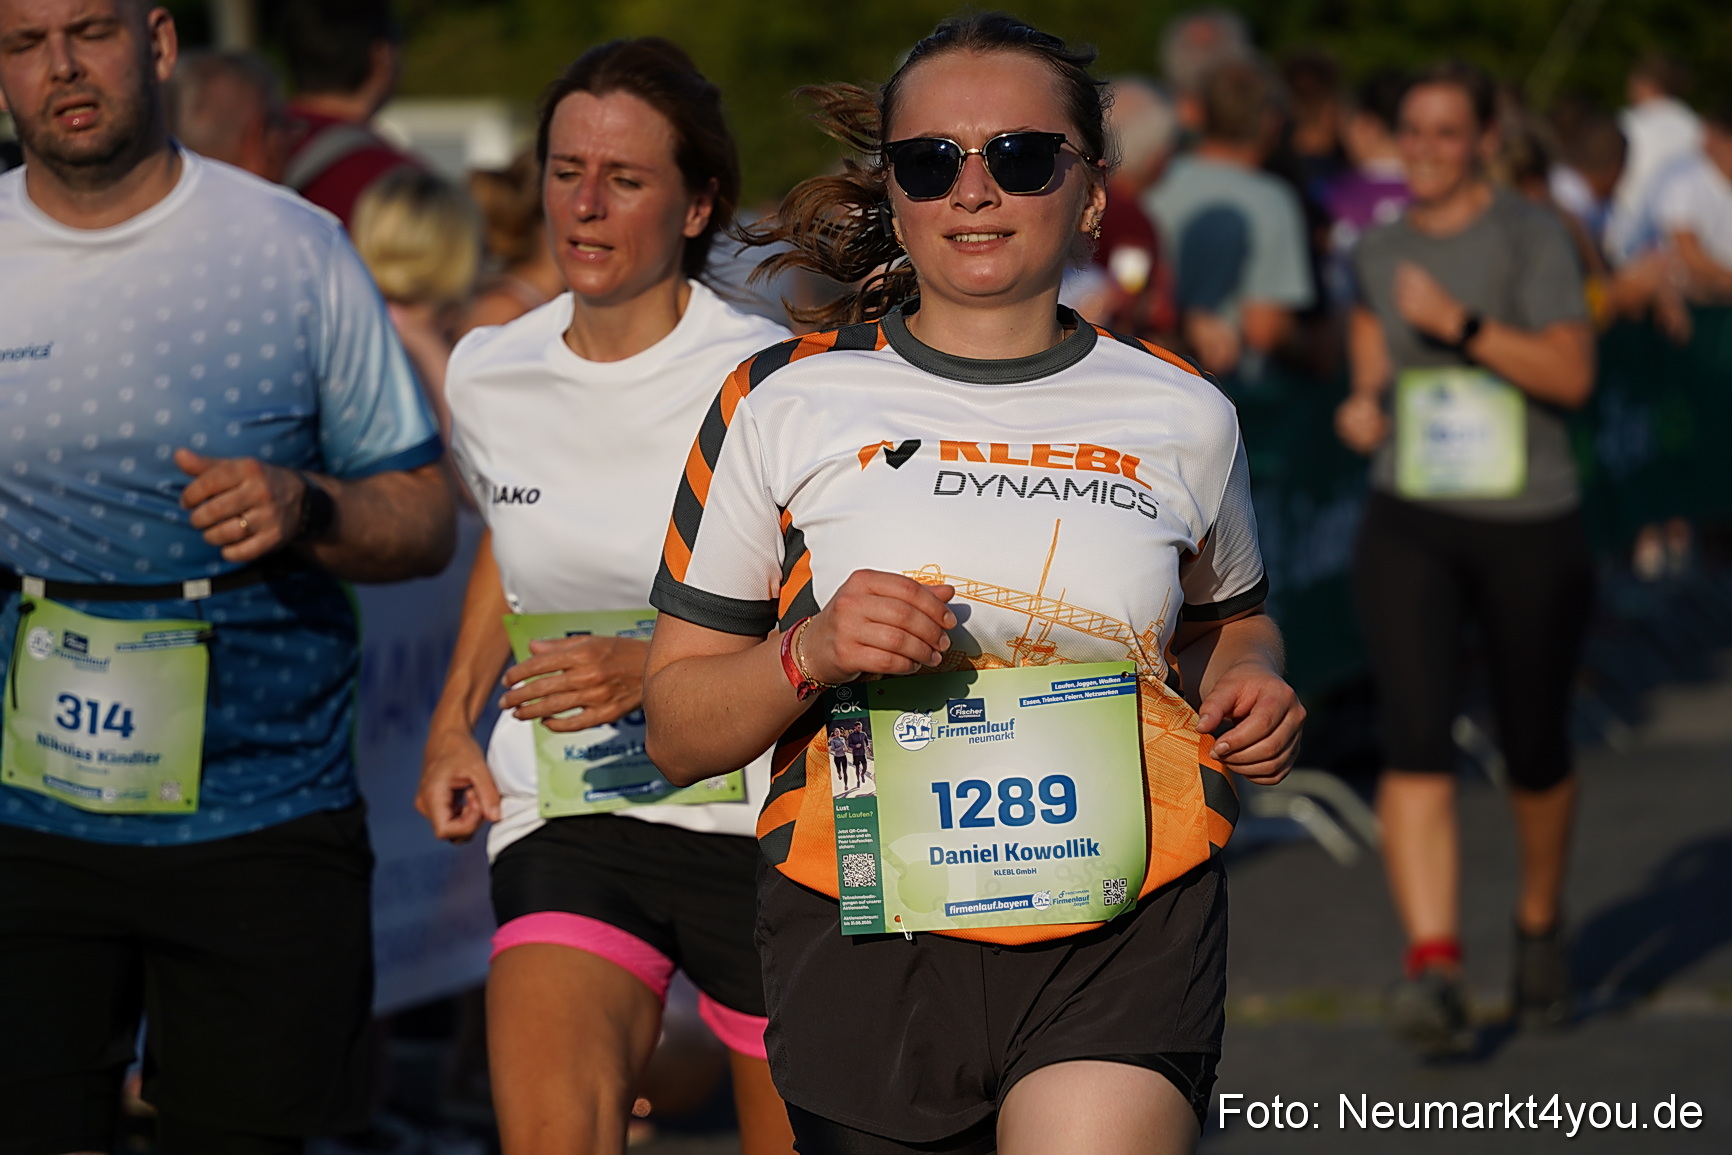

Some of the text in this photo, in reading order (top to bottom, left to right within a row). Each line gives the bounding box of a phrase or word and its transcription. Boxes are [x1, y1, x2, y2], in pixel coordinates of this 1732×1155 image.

[938, 439, 1153, 491] KLEBL
[933, 469, 1159, 519] DYNAMICS
[1075, 679, 1098, 688] Joggen,
[1098, 677, 1121, 685] Walken
[1041, 696, 1064, 704] Trinken,
[1064, 692, 1084, 701] Feiern,
[1084, 689, 1119, 698] Netzwerken
[56, 691, 135, 738] 314
[830, 701, 863, 714] AOK
[955, 707, 983, 715] Fischer
[937, 718, 1015, 739] Firmenlauf
[968, 731, 1015, 744] neumarkt
[36, 731, 92, 762] Nikolas
[931, 774, 1077, 829] 1289
[929, 838, 1101, 866] Daniel Kowollik
[993, 867, 1037, 876] KLEBL GmbH
[949, 899, 1029, 915] firmenlauf.bayern
[1052, 894, 1090, 905] Firmenlauf
